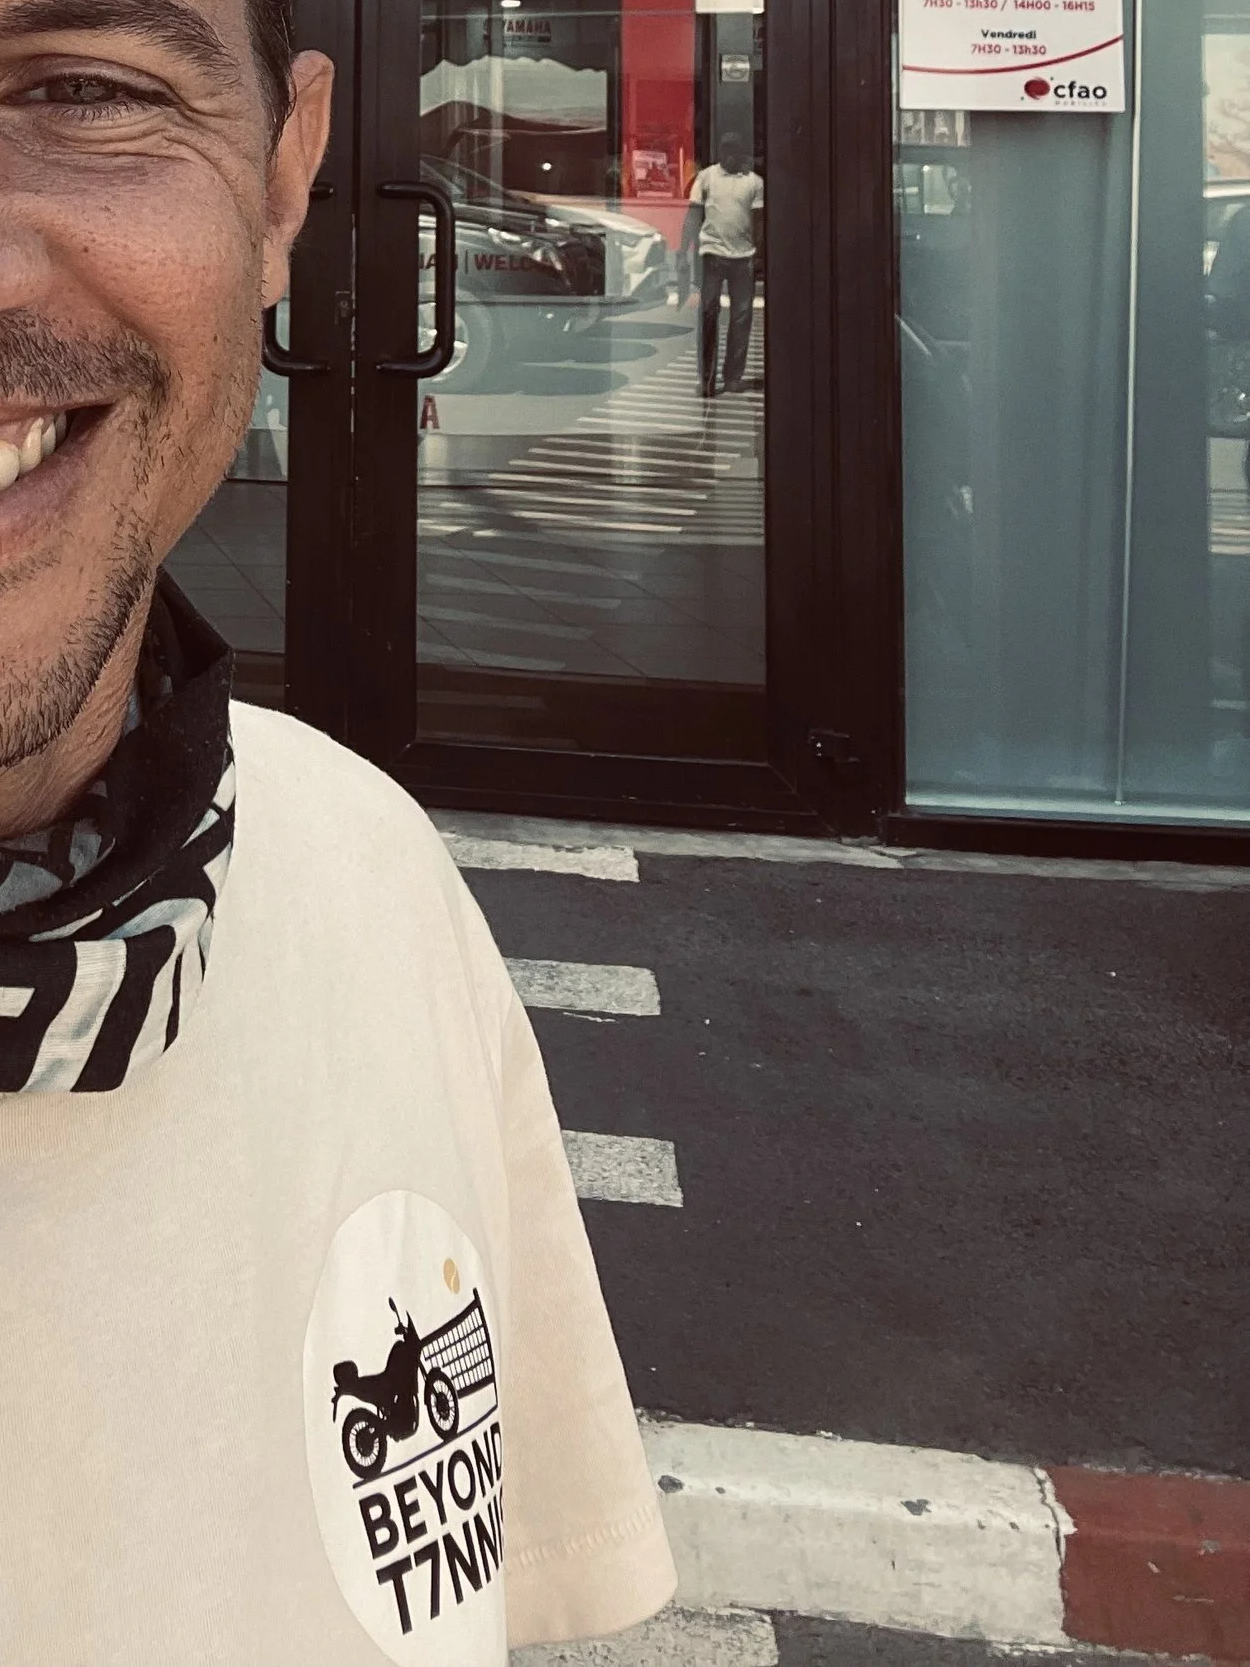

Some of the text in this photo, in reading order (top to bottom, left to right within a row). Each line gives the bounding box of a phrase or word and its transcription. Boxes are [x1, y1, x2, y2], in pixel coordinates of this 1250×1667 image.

[1013, 0, 1051, 10] 14H00
[1062, 0, 1095, 11] 16H15
[500, 18, 551, 34] AMAHA
[980, 29, 1037, 40] Vendredi
[970, 44, 1001, 55] 7H30
[1013, 44, 1047, 56] 13h30
[1053, 79, 1107, 100] cfao
[358, 1421, 503, 1560] BEYOND
[376, 1486, 505, 1635] T7NNI
